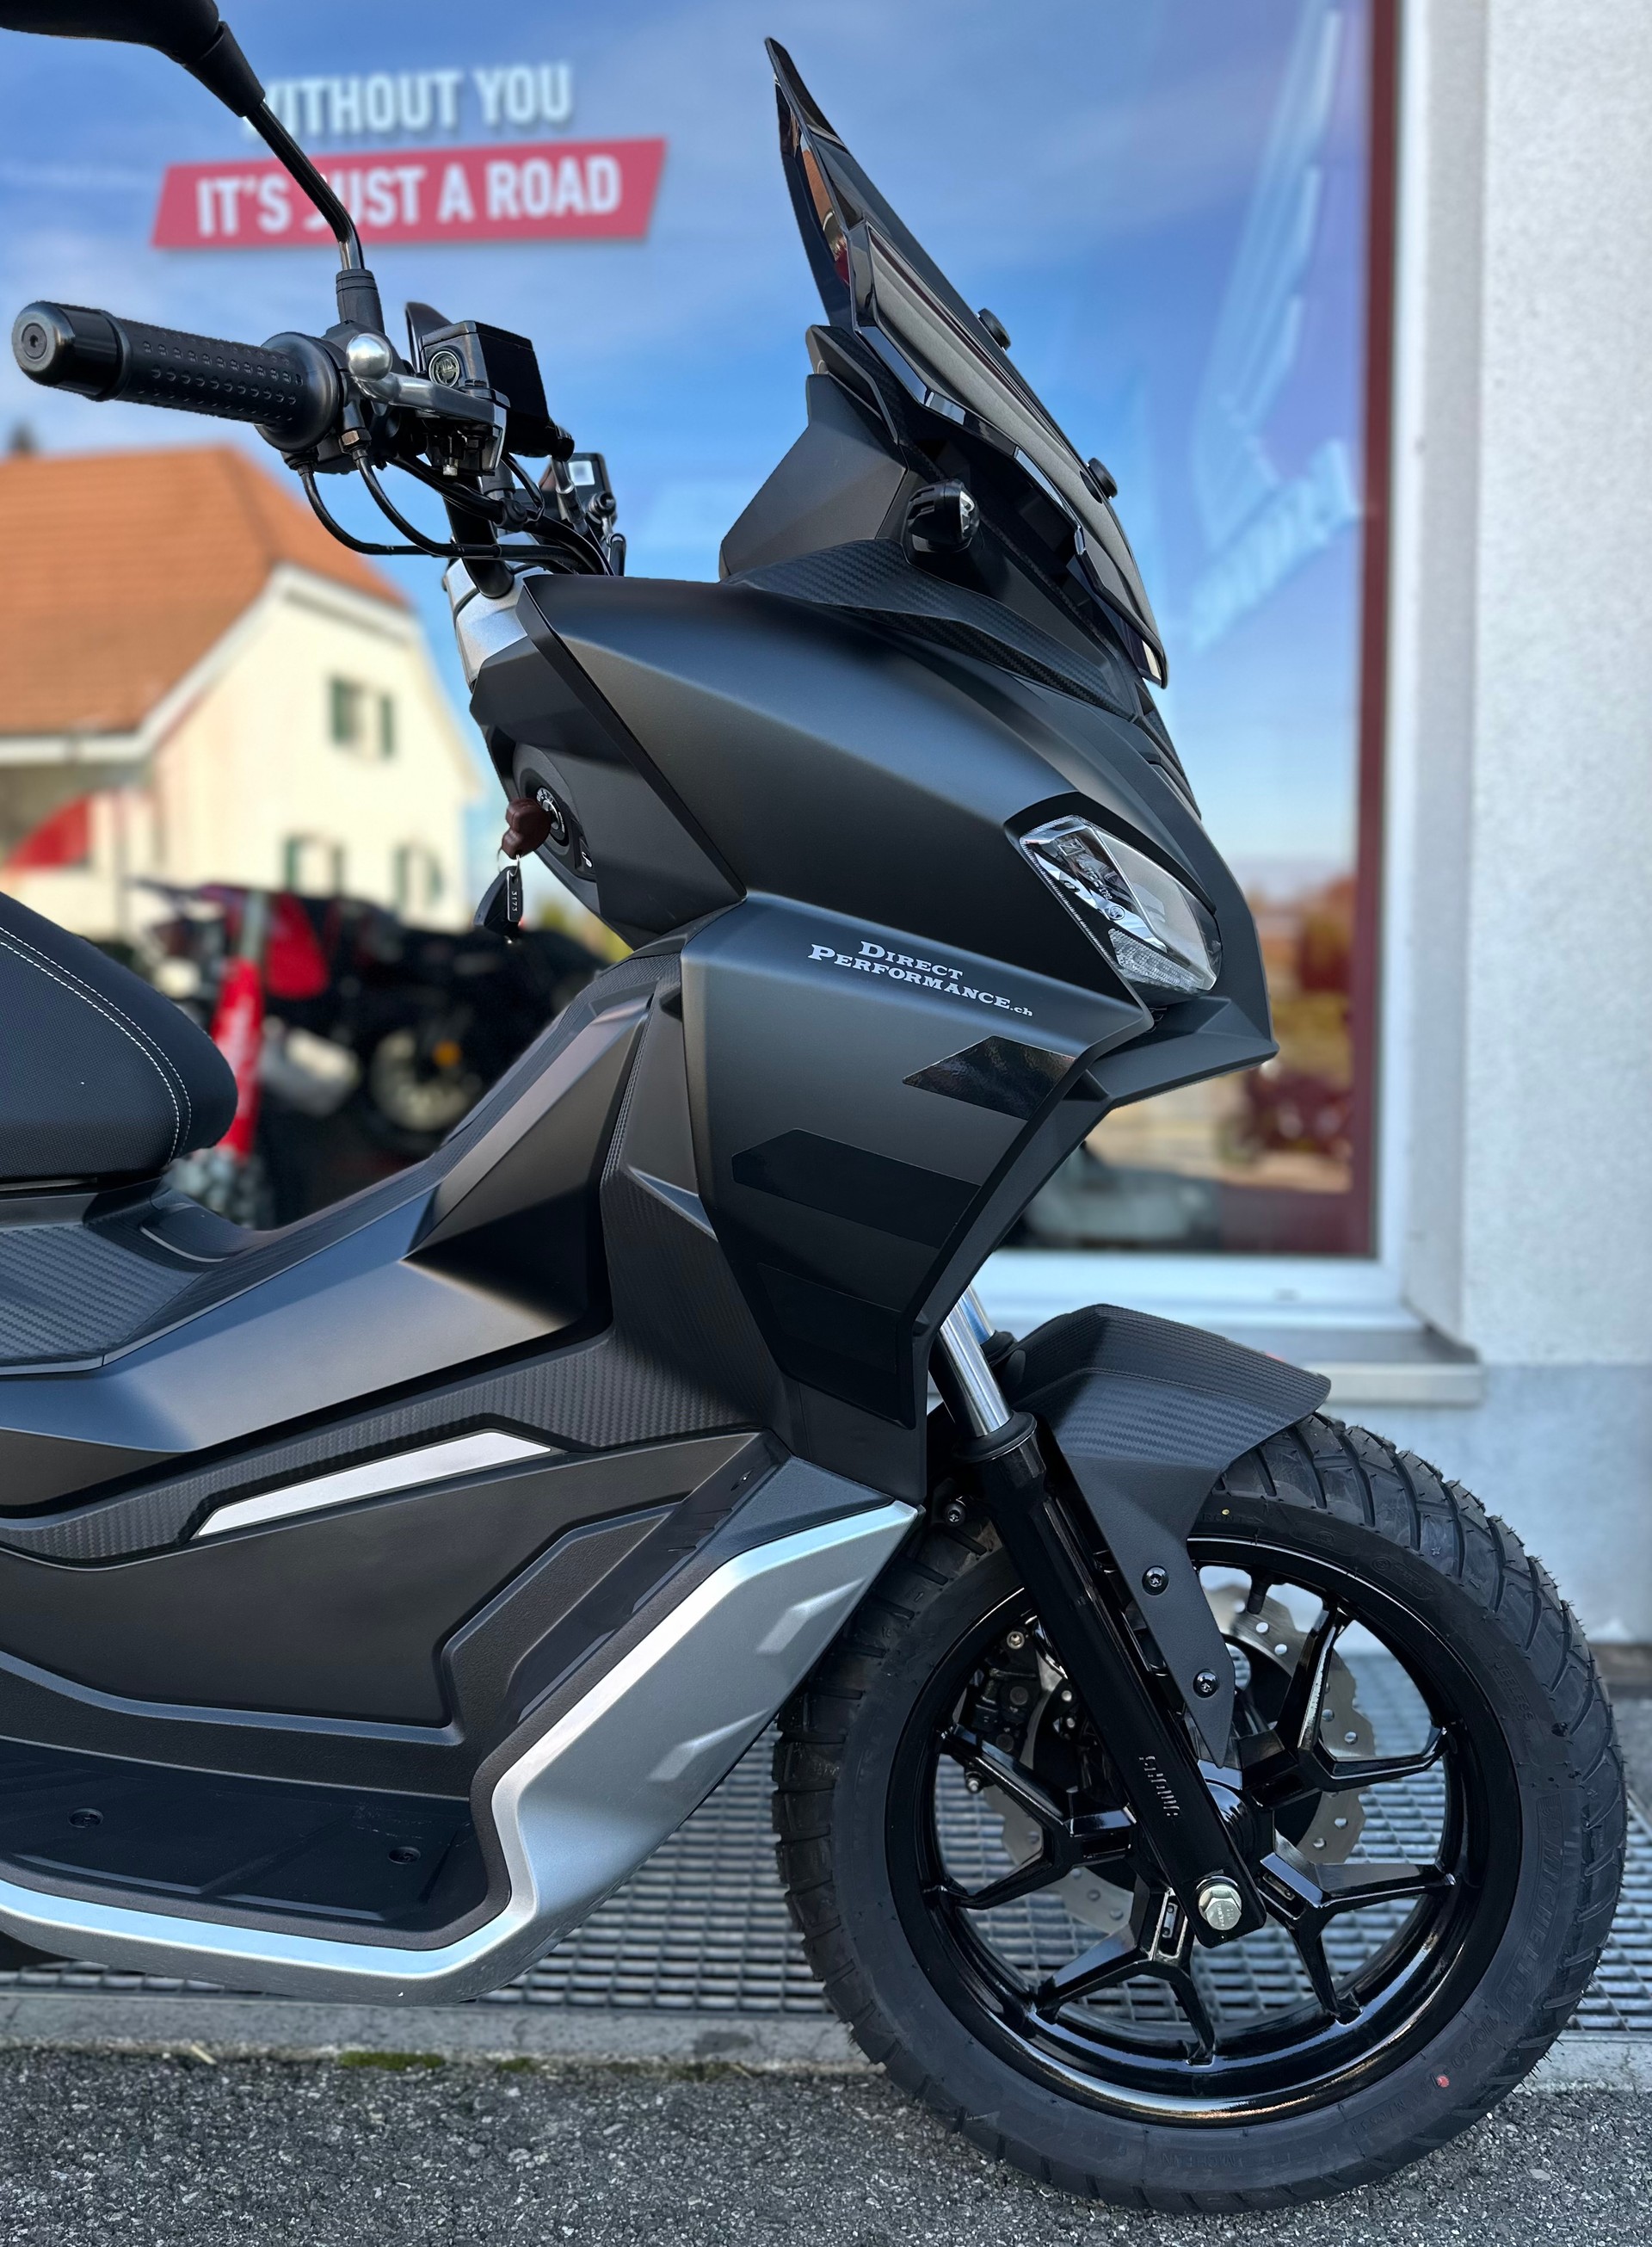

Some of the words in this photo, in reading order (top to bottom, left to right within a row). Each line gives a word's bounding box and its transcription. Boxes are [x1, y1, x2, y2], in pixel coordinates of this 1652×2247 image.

[473, 63, 574, 127] YOU
[196, 174, 293, 237] IT'S
[437, 162, 475, 225] A
[486, 154, 623, 221] ROAD
[1505, 1838, 1562, 2003] MICHELIN
